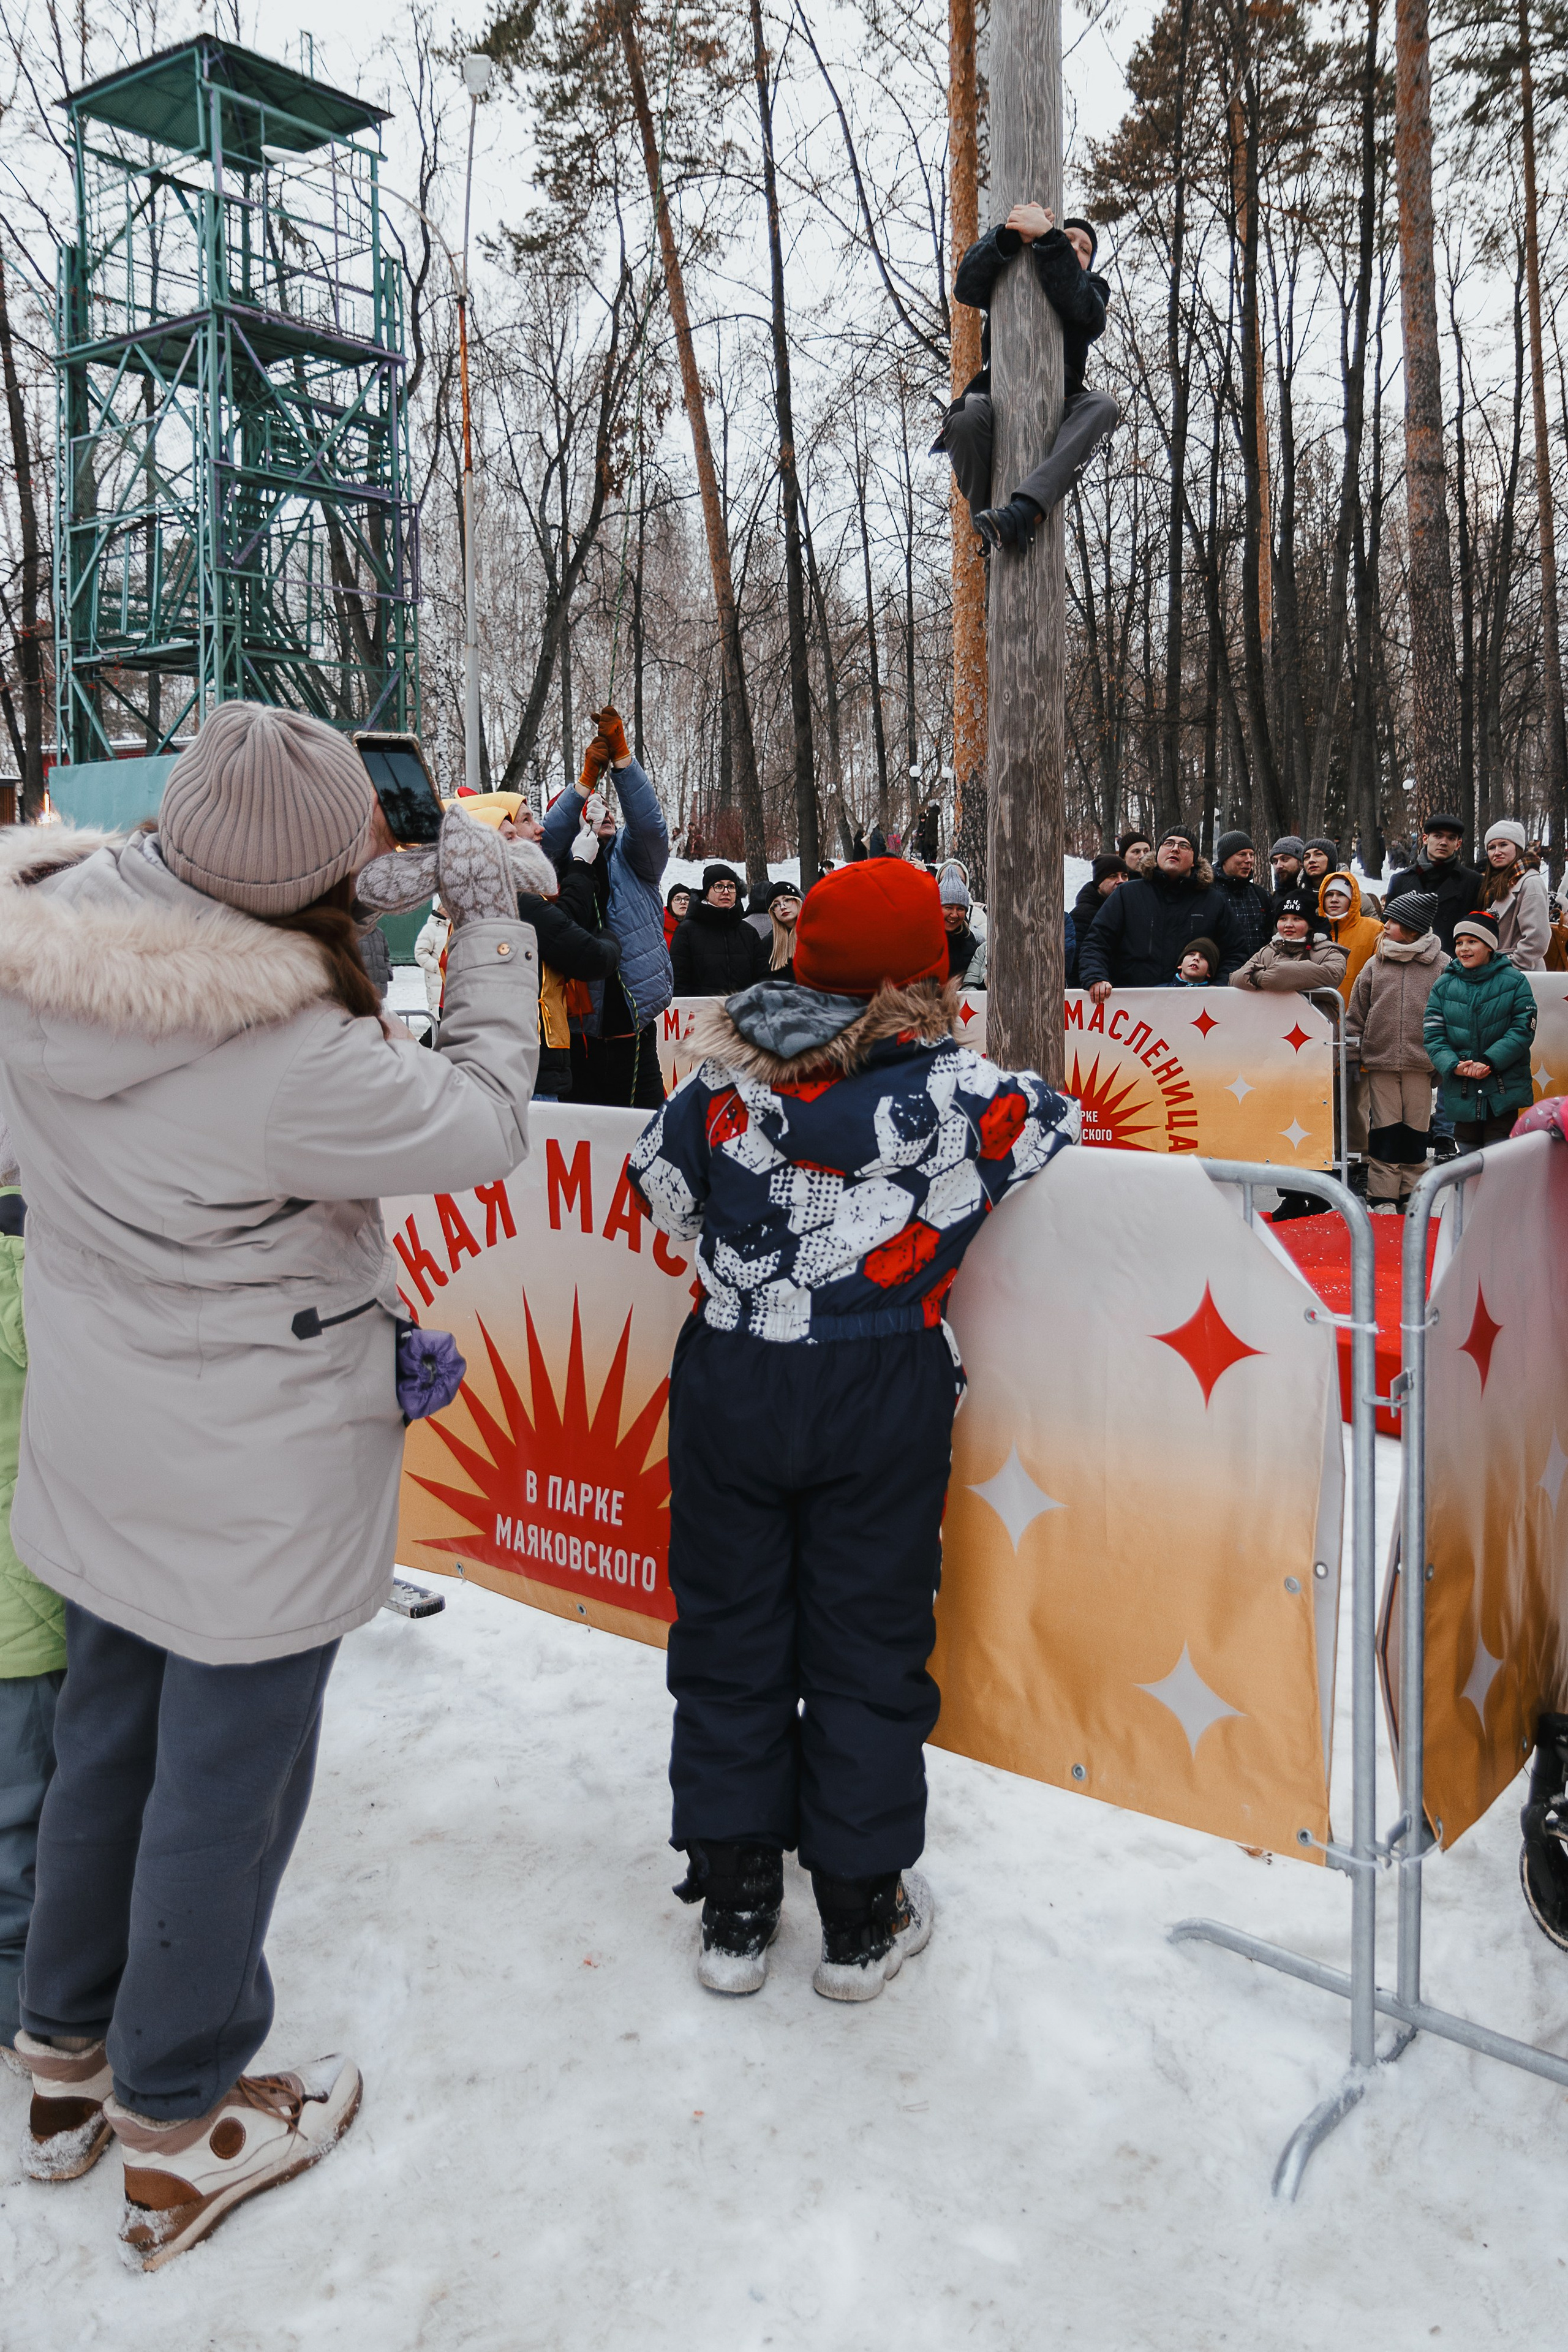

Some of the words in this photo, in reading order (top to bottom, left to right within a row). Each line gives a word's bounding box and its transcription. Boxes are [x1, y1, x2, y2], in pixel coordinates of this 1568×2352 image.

[1065, 1000, 1198, 1152] МАСЛЕНИЦА
[393, 1178, 517, 1323] КАЯ
[496, 1513, 656, 1591] МАЯКОВСКОГО
[527, 1469, 537, 1503] В
[548, 1475, 624, 1526] ПАРКЕ
